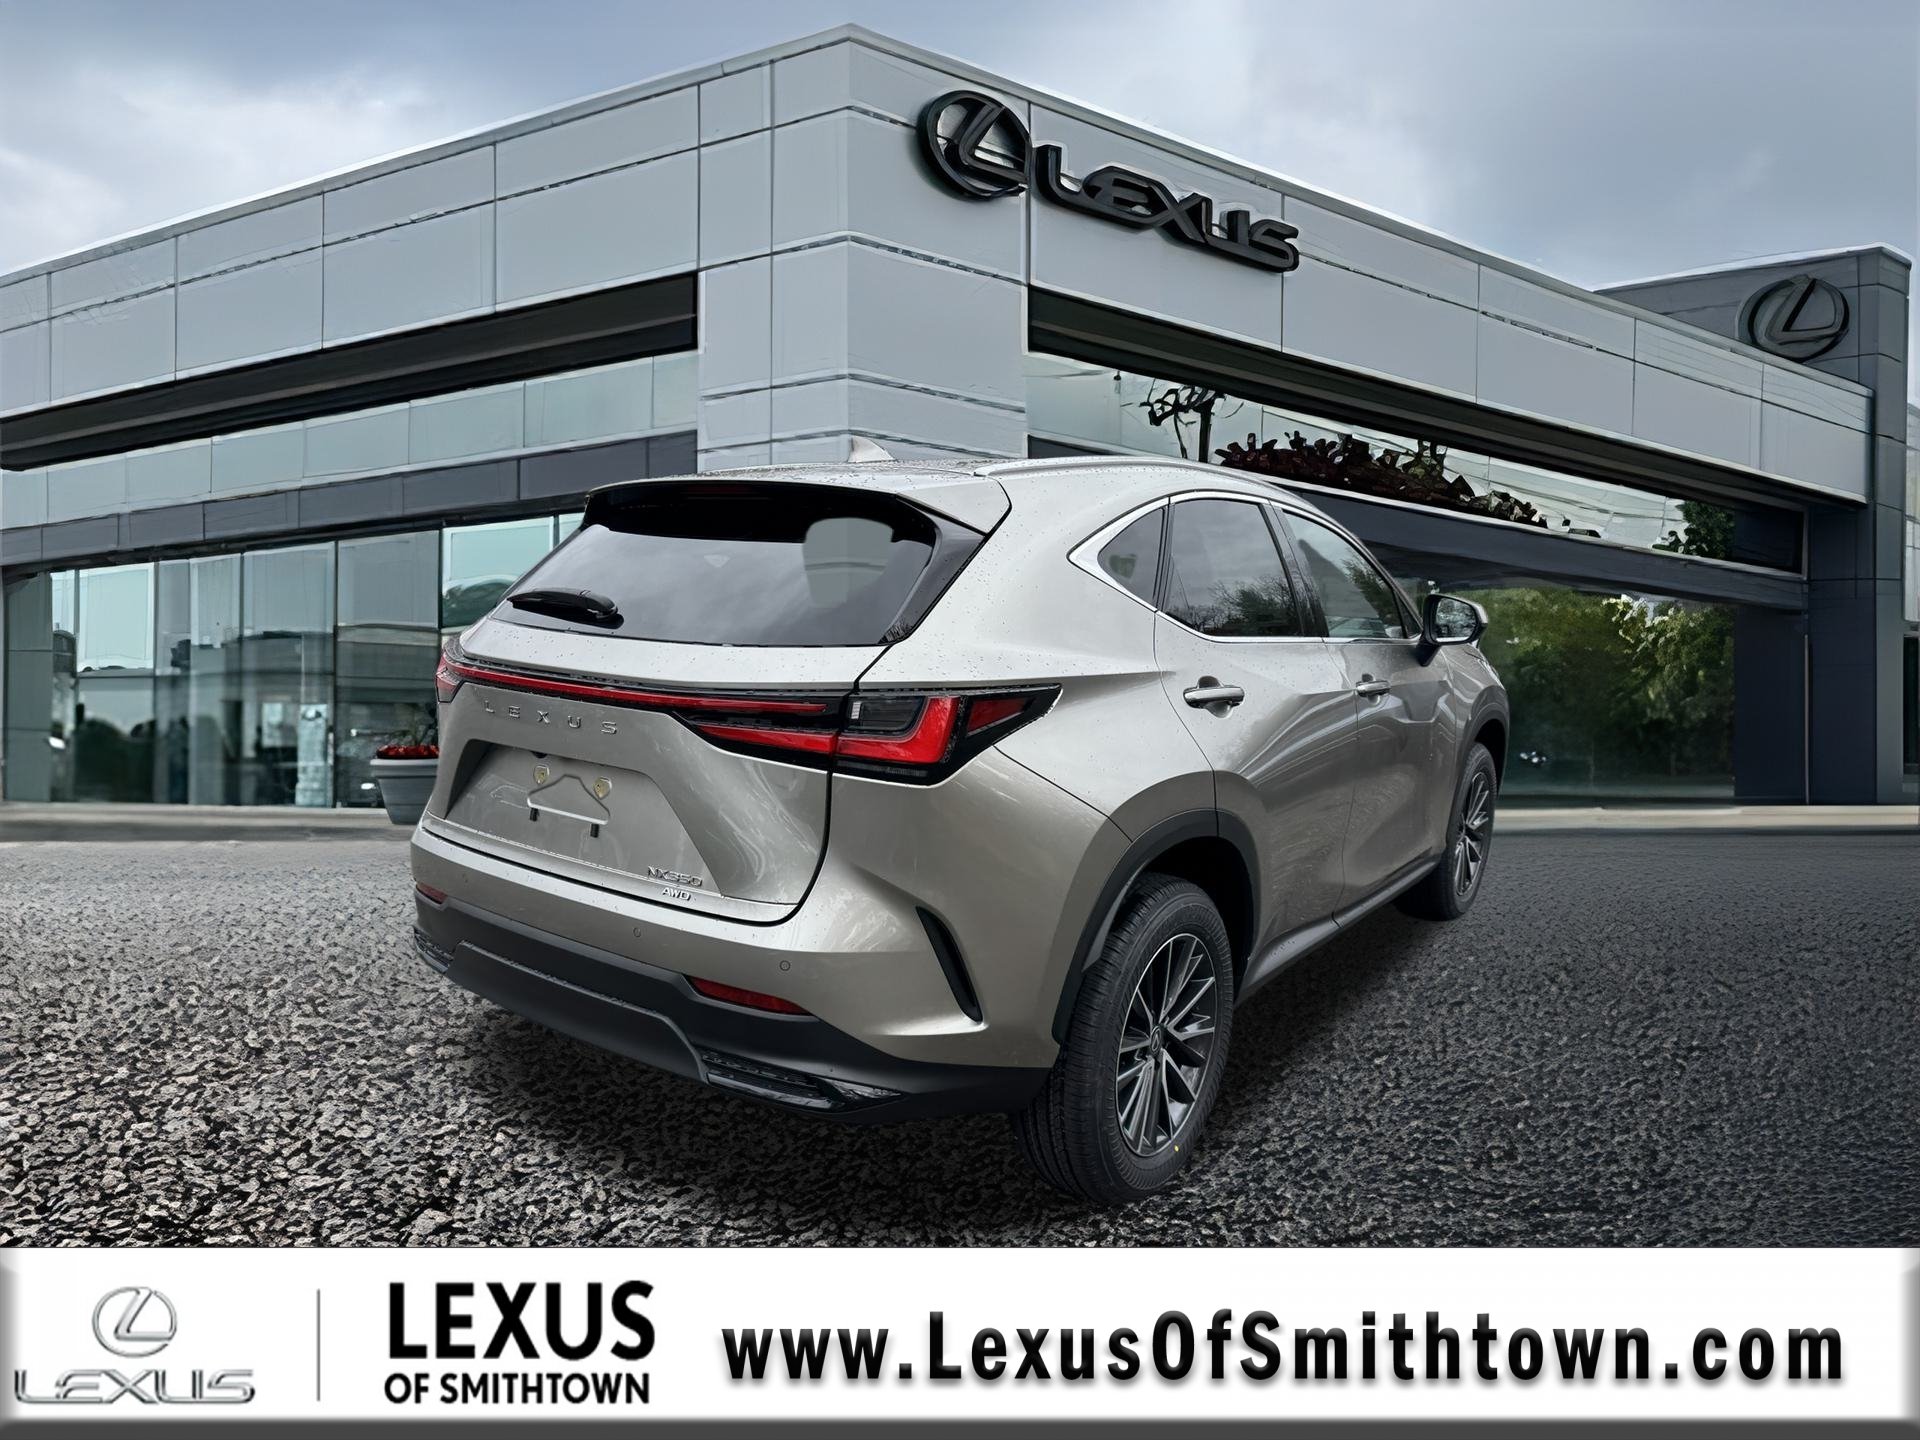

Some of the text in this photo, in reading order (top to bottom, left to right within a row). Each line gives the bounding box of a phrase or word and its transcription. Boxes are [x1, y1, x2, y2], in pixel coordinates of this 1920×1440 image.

[1034, 143, 1300, 273] LEXUS
[484, 700, 618, 735] LEXUS
[662, 887, 692, 901] AWD
